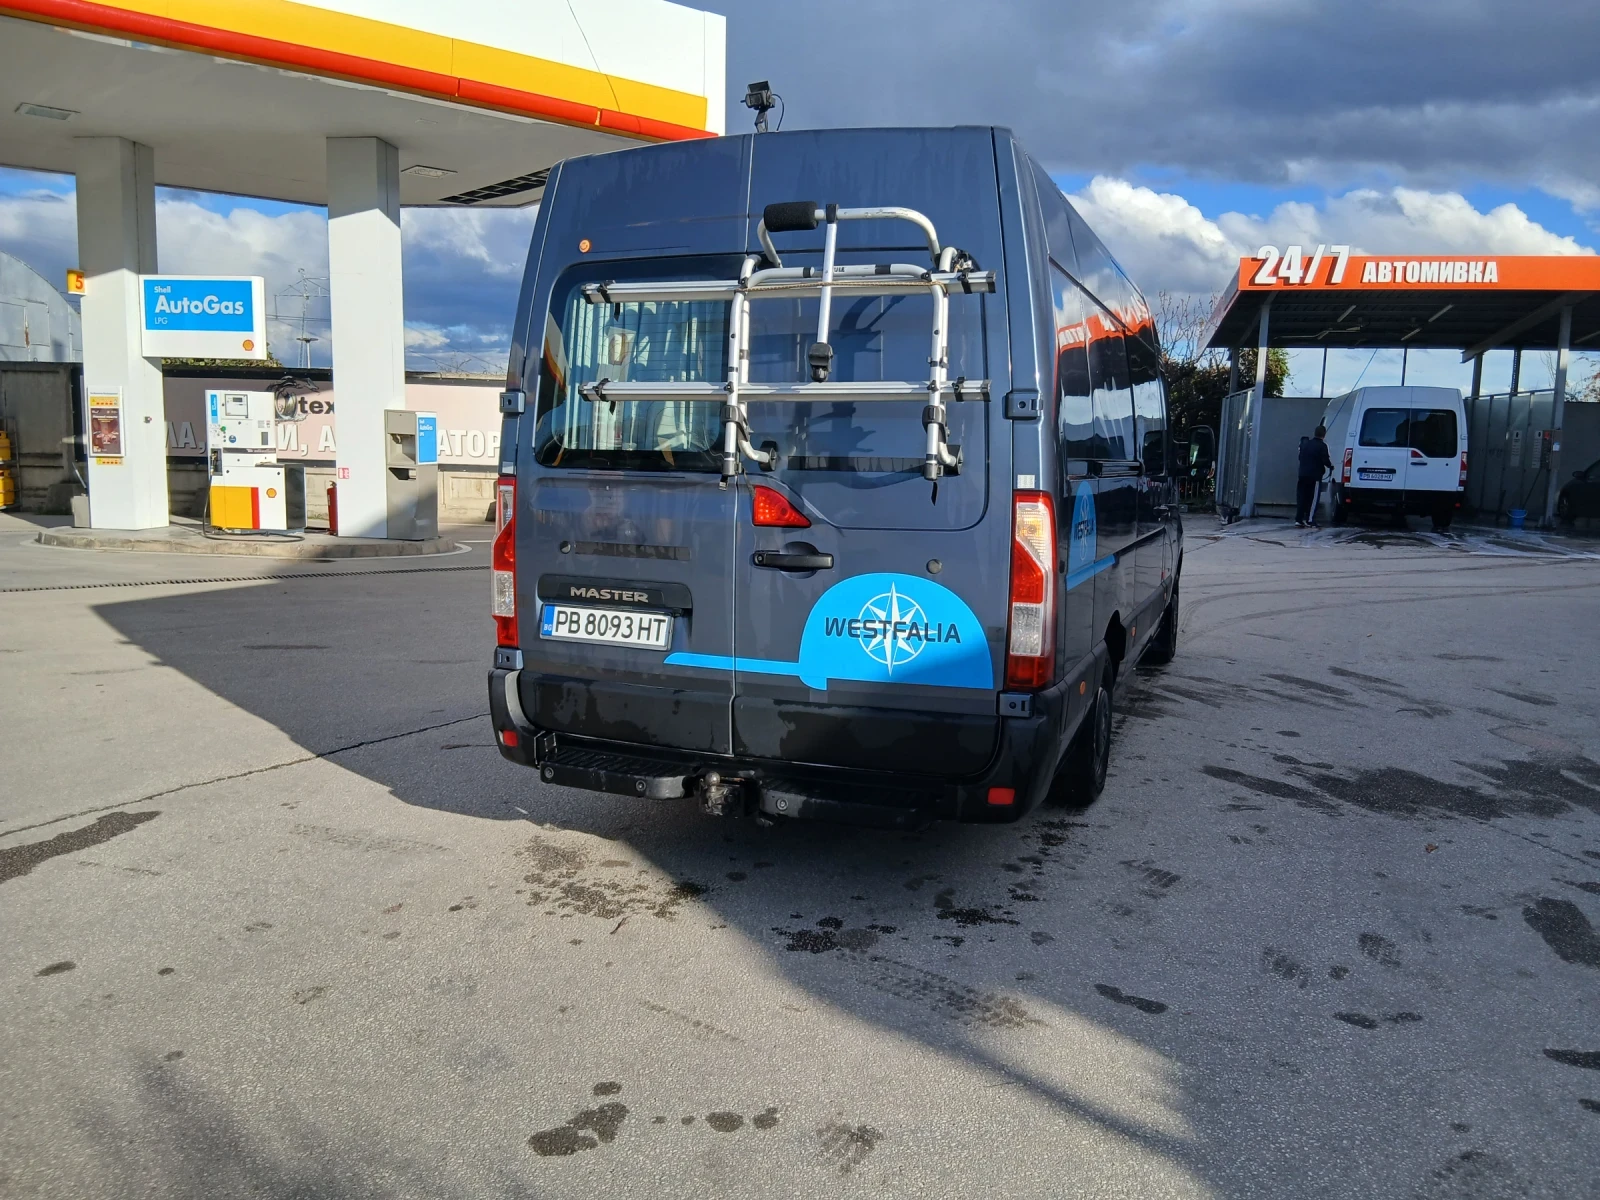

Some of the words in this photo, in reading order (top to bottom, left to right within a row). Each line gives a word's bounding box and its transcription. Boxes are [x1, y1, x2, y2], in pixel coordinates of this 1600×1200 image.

[1254, 244, 1350, 284] 24/7
[1362, 261, 1498, 283] АВТОМИВКА
[75, 275, 83, 290] 5
[155, 295, 244, 315] AutoGas
[154, 317, 168, 325] LPG
[571, 587, 648, 602] MASTER
[555, 610, 580, 634] PB
[585, 613, 633, 638] 8093
[637, 617, 666, 641] HT
[825, 617, 961, 643] WESTFALIA
